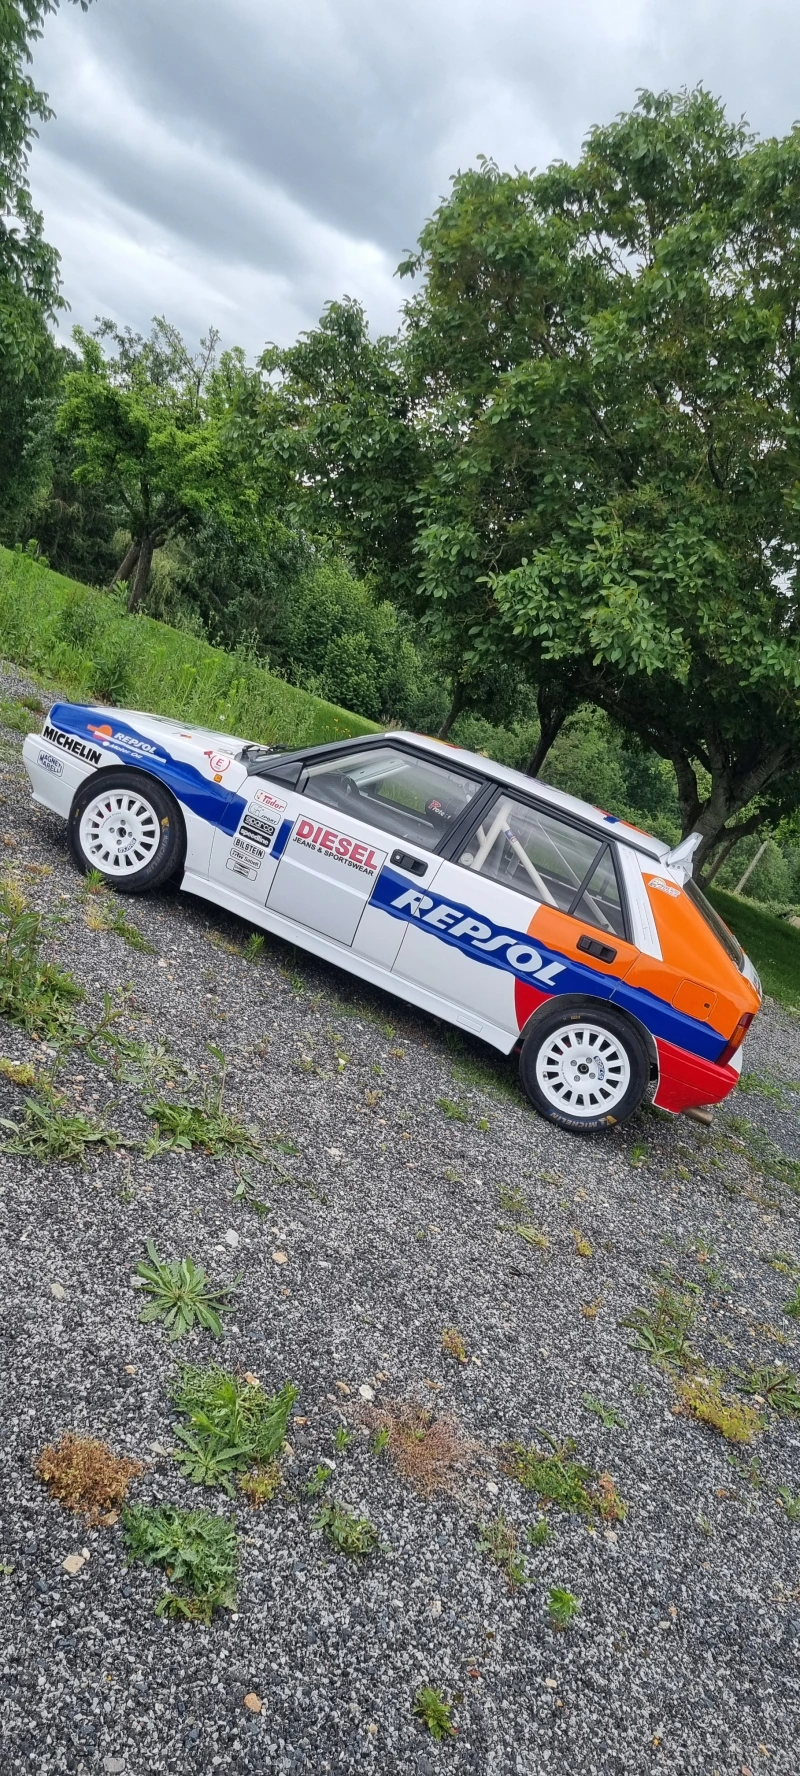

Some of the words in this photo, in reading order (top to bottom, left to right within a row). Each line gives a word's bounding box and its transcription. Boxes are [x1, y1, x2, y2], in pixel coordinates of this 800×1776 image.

[43, 726, 102, 765] MICHELIN
[113, 732, 158, 755] REPSOL
[216, 758, 225, 767] E
[262, 794, 285, 809] Tudor
[245, 815, 274, 833] sparco
[240, 828, 269, 845] speedline
[296, 820, 378, 871] DIESEL
[235, 838, 264, 857] BILSTEIN
[293, 836, 317, 851] JEANS
[323, 850, 374, 876] SPORTSWEAR
[390, 888, 567, 987] REPSOL
[550, 1112, 598, 1128] MICHELIN
